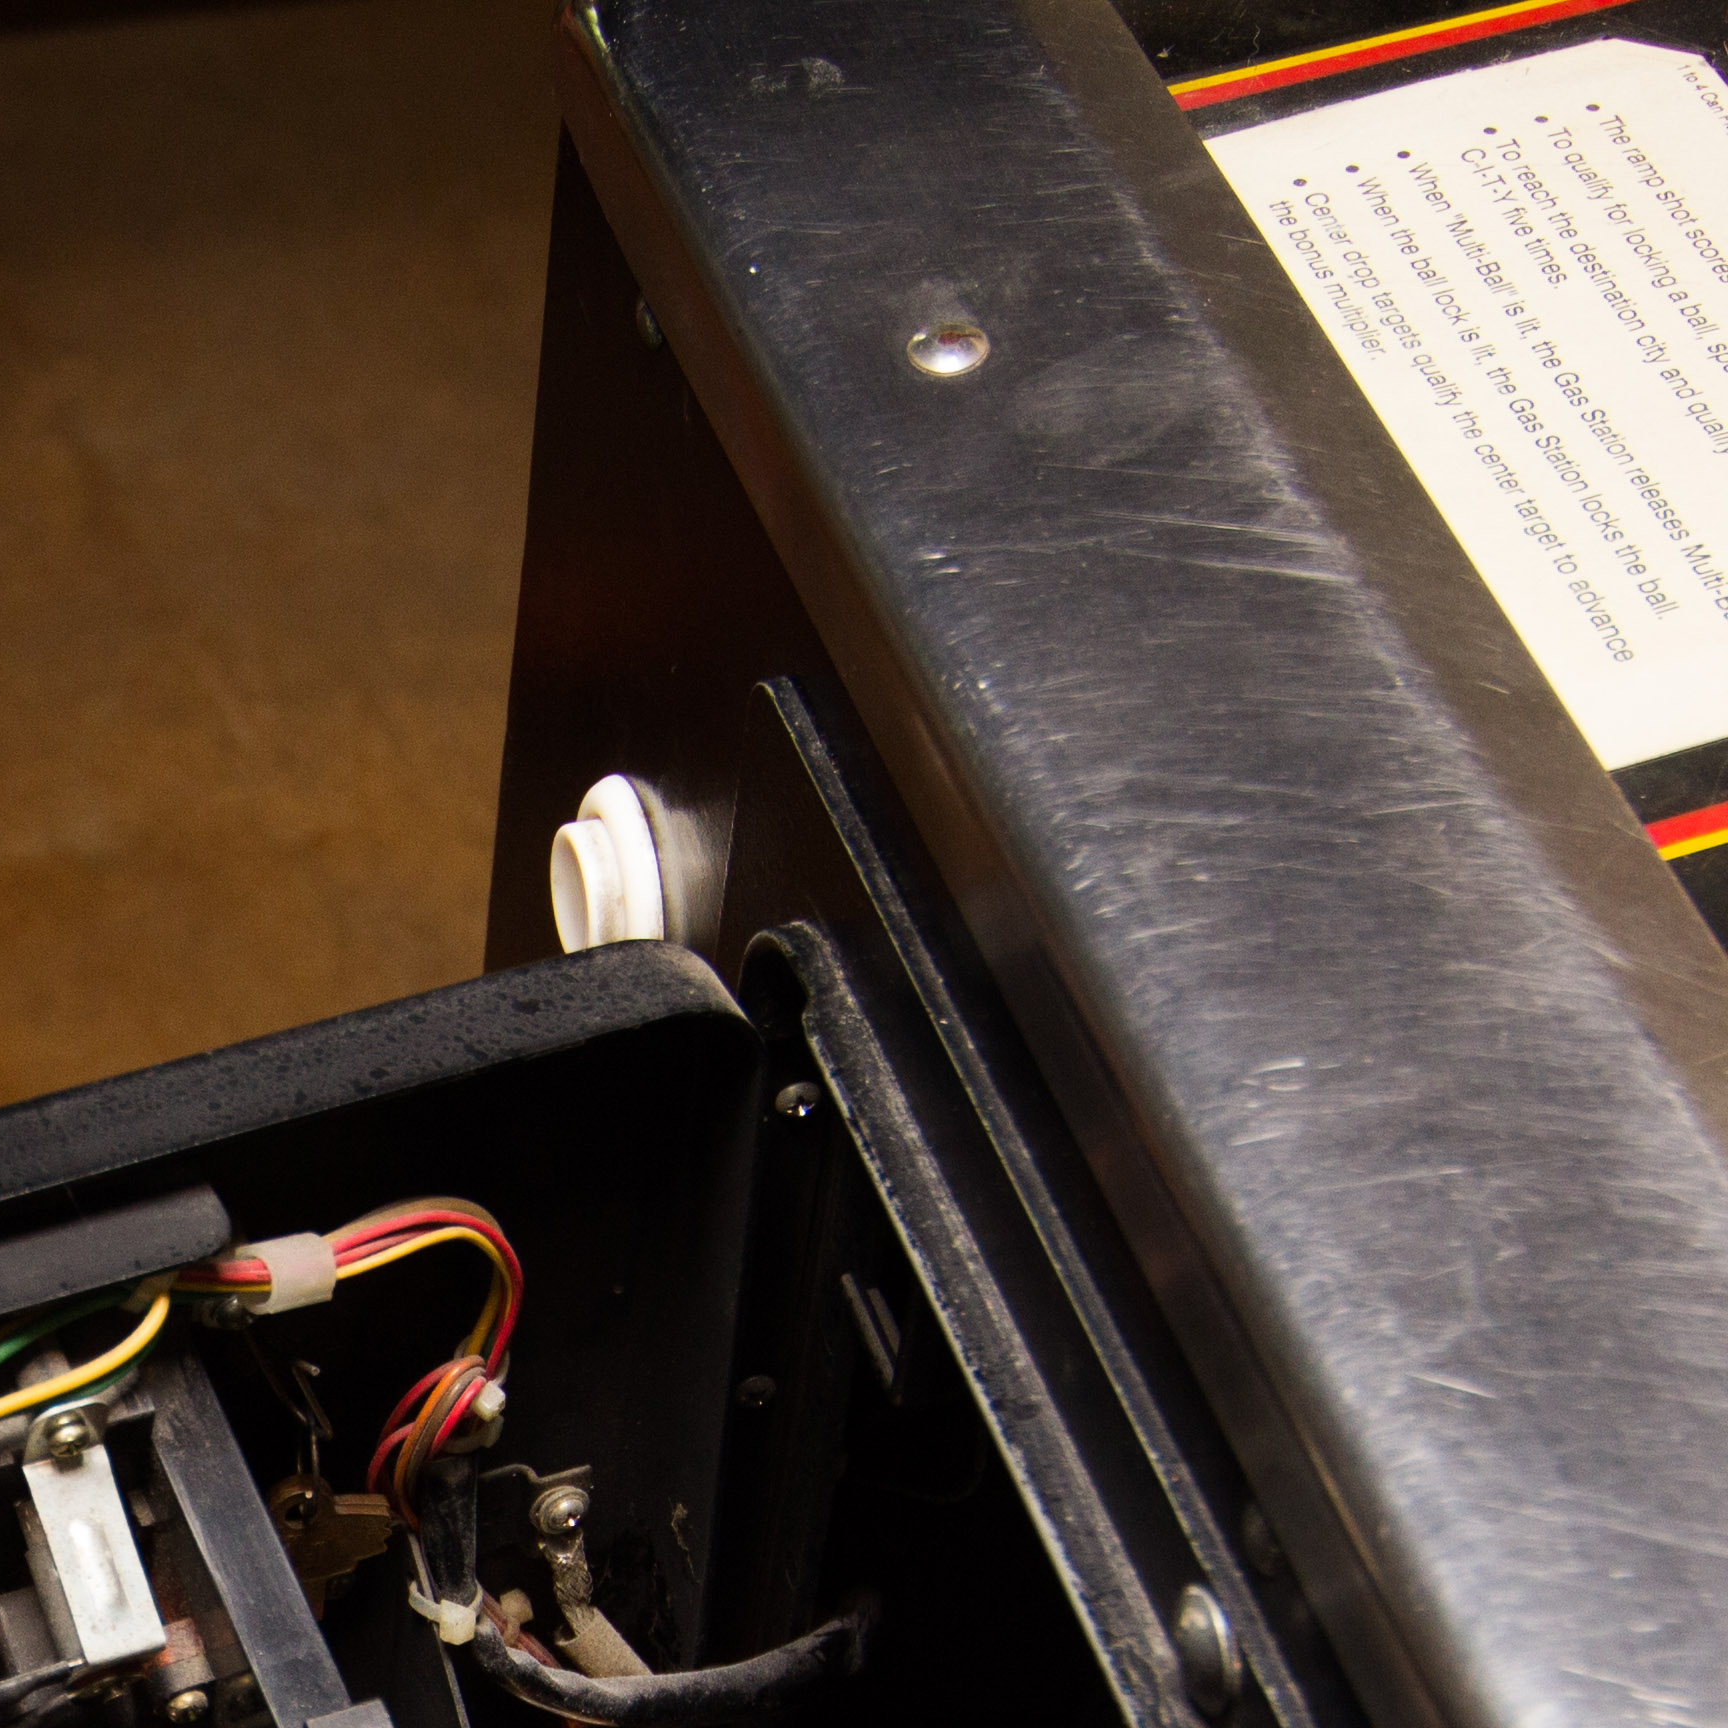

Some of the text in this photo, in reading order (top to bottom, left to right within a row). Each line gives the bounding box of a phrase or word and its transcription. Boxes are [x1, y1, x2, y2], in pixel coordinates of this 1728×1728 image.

[1683, 71, 1699, 83] to
[1695, 84, 1710, 92] 4
[1700, 92, 1725, 115] Can
[1461, 147, 1568, 288] C-I-T-Y five times.
[1548, 126, 1574, 149] To
[1564, 153, 1614, 200] qualify
[1604, 203, 1633, 224] for
[1624, 228, 1678, 288] locking
[1668, 291, 1689, 303] a
[1679, 303, 1719, 339] ball,
[1600, 114, 1632, 144] The
[1623, 148, 1666, 187] ramp
[1656, 189, 1699, 226] shot
[1269, 200, 1386, 361] the bonus multiplier.
[1496, 138, 1522, 161] To
[1512, 164, 1559, 210] reach
[1548, 211, 1578, 238] the
[1570, 243, 1646, 331] destination
[1636, 335, 1670, 363] city
[1660, 368, 1703, 399] and
[1305, 192, 1634, 660] Center drop targets qualify the center target to advance
[1358, 176, 1679, 620] When the ball lock is lit, the Gas Station locks the ball.
[1409, 162, 1452, 212] When
[1503, 300, 1525, 316] is
[1516, 317, 1541, 339] lit,
[1532, 340, 1563, 368] the
[1554, 372, 1590, 406] Gas
[1581, 409, 1635, 464] Station
[1626, 467, 1690, 540] releases
